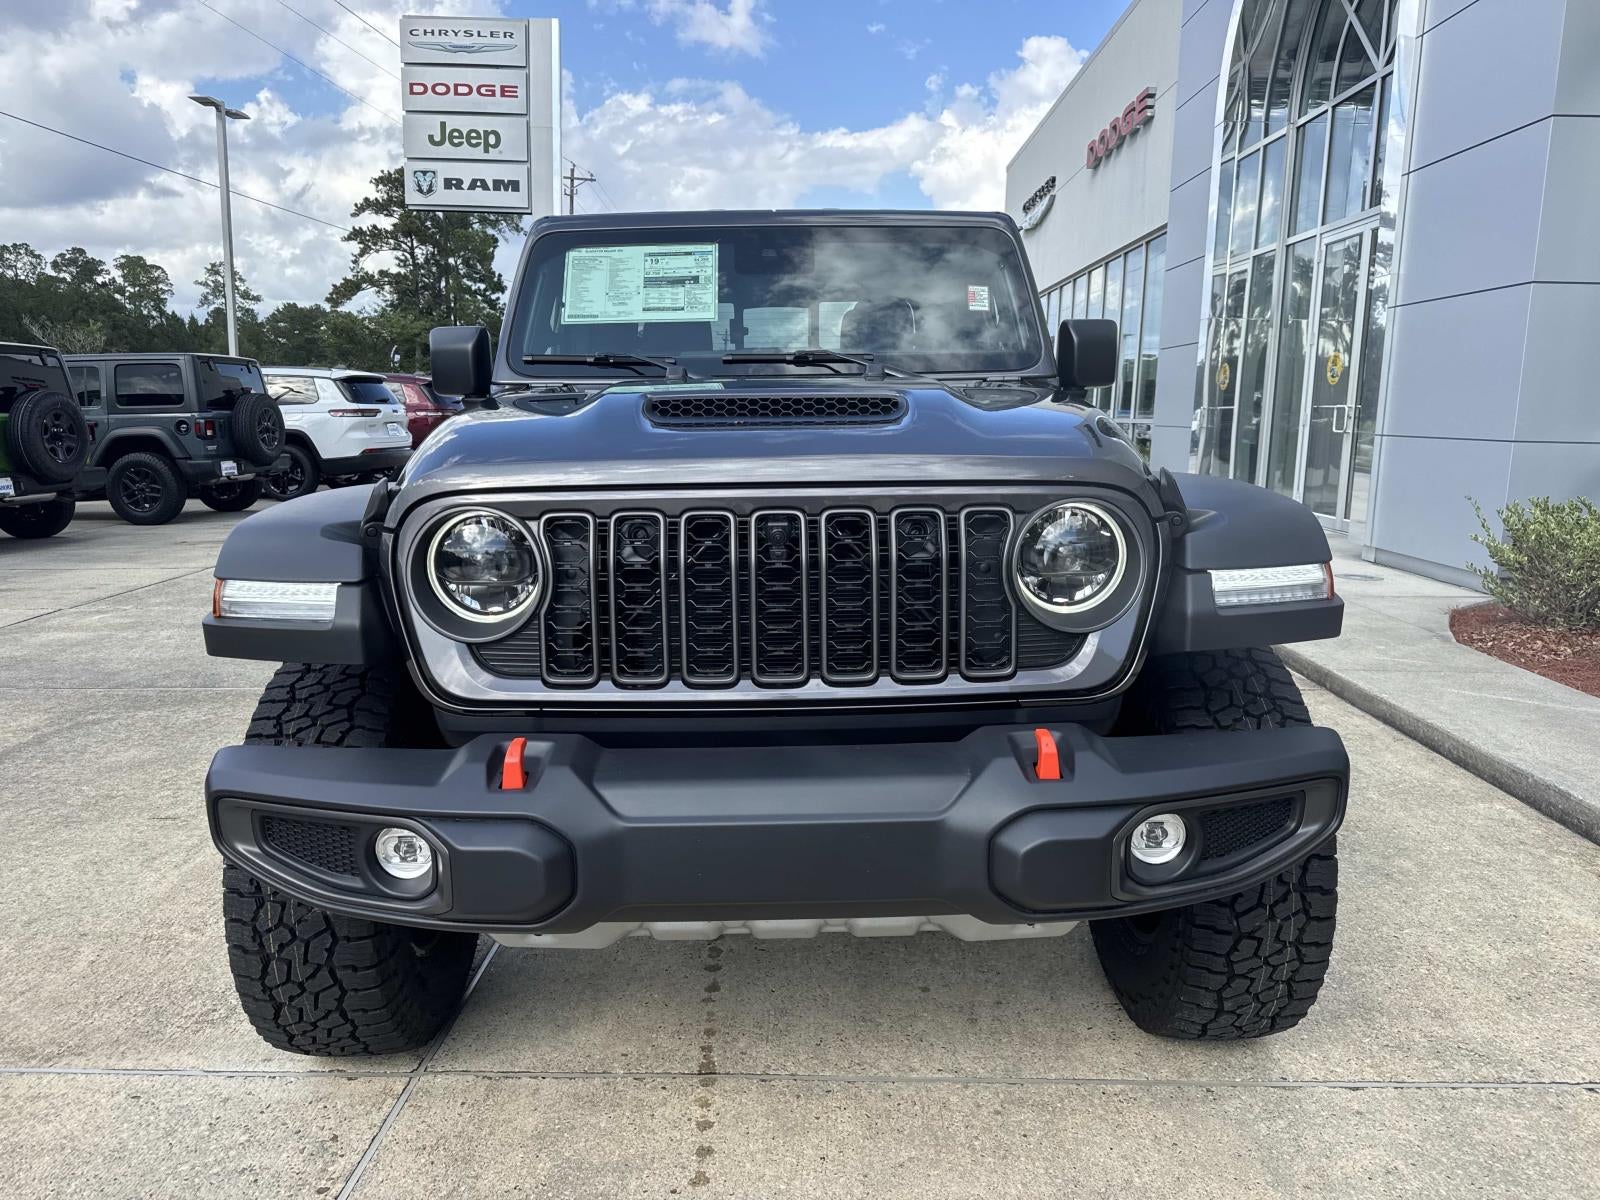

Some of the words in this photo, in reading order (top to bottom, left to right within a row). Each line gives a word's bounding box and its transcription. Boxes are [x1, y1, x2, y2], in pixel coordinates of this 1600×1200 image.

[408, 28, 515, 39] CHRYSLER
[408, 82, 519, 99] DODGE
[1086, 87, 1157, 169] DODGE
[427, 120, 502, 154] Jeep
[443, 177, 520, 193] RAM
[649, 257, 660, 265] 19
